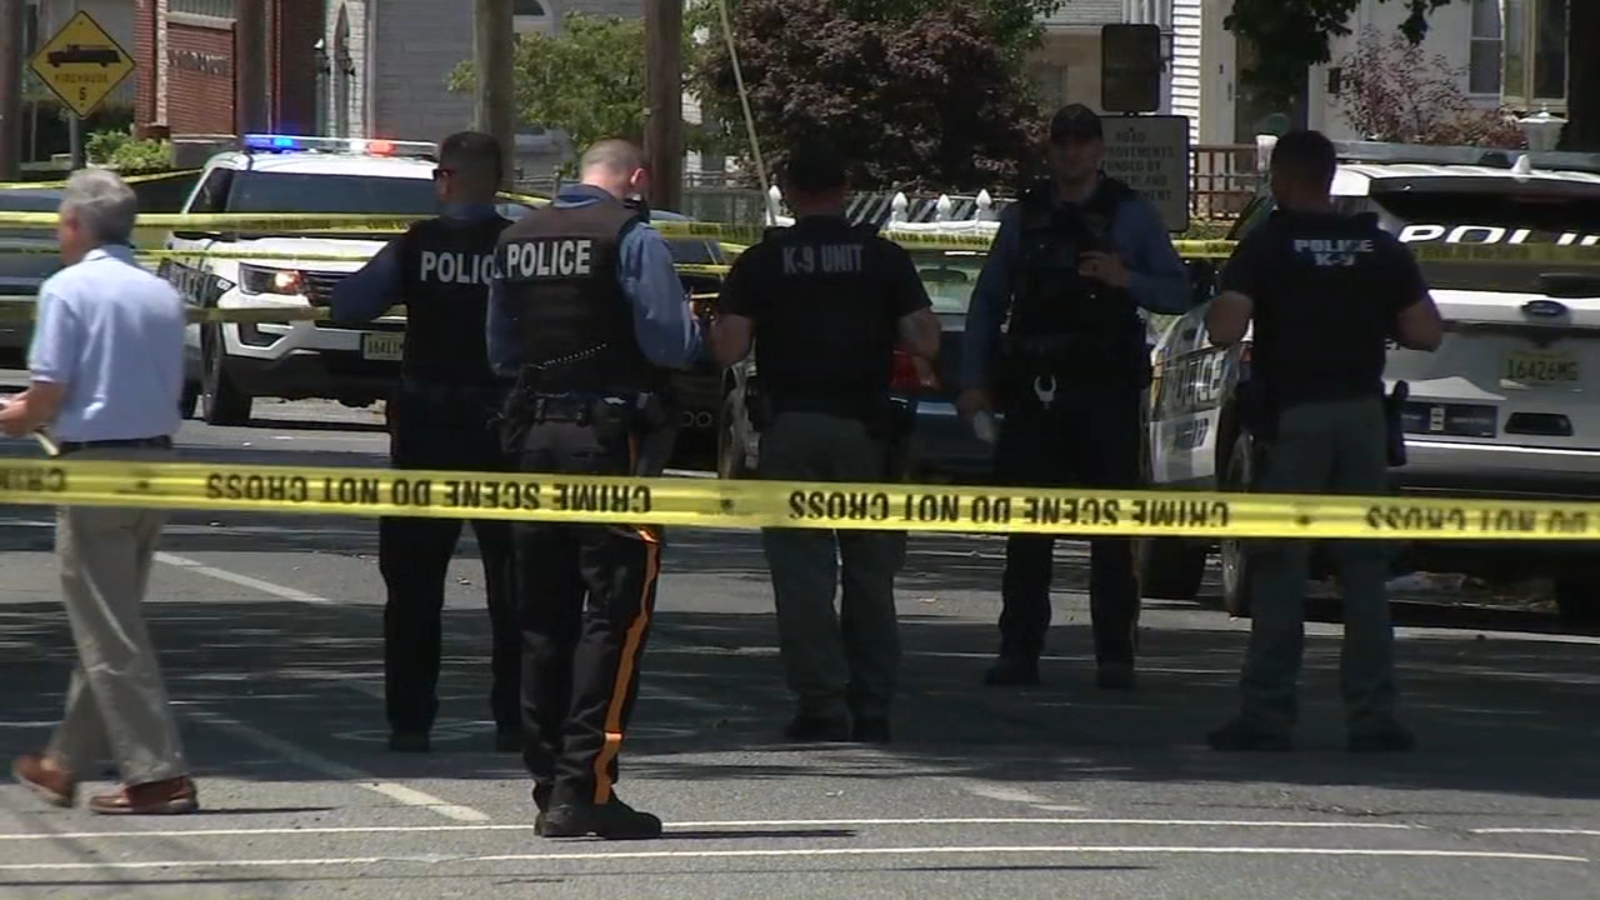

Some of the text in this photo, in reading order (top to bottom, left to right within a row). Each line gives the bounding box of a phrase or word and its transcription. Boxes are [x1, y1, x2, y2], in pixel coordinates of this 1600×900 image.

[507, 240, 592, 278] POLICE
[782, 244, 864, 274] K-9 UNIT
[1293, 239, 1374, 253] POLICE
[420, 250, 493, 285] POLIC
[206, 473, 651, 514] CRIME SCENE DO NOT CROSS
[789, 489, 1230, 528] CRIME SCENE DO NOT CROSS
